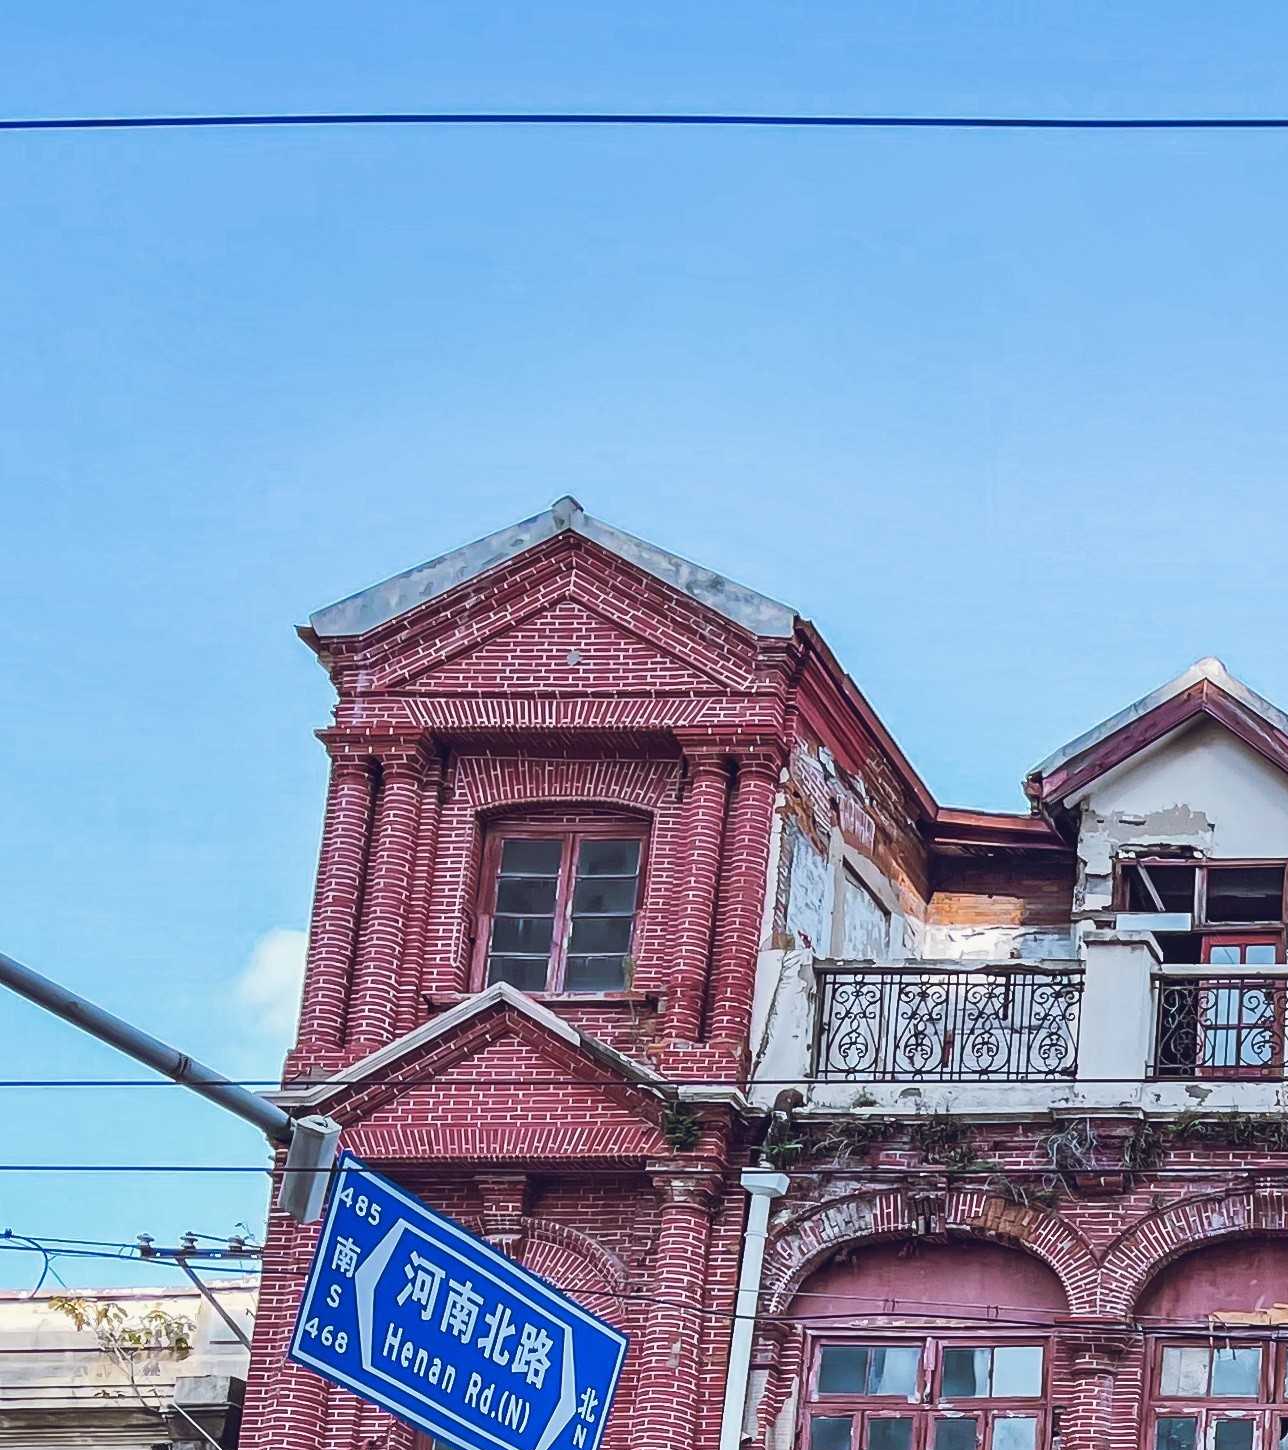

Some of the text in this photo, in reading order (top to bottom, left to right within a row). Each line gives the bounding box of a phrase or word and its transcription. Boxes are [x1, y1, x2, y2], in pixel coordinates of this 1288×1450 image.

[339, 1187, 381, 1226] 485
[332, 1235, 361, 1279] 南
[327, 1284, 341, 1307] S
[304, 1317, 349, 1354] 468
[397, 1250, 554, 1390] 河南北路
[383, 1323, 456, 1393] Henan
[578, 1386, 598, 1423] 北
[573, 1424, 587, 1449] N
